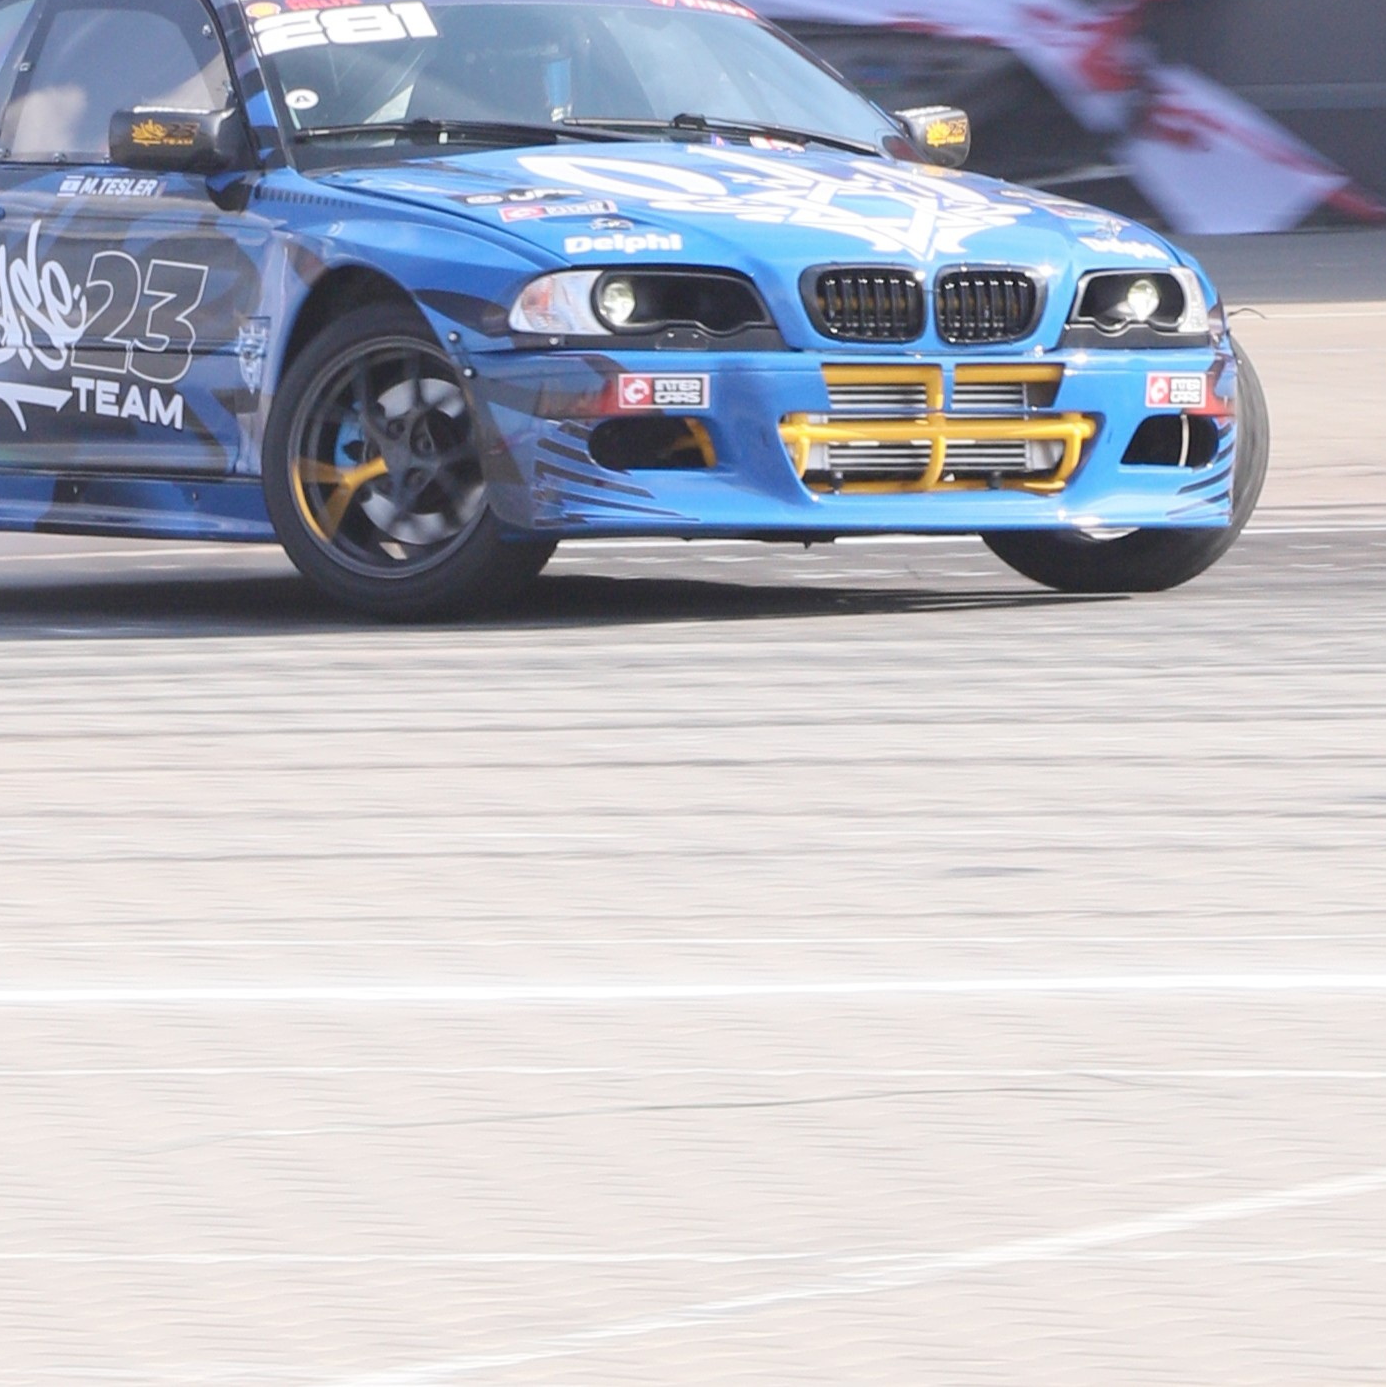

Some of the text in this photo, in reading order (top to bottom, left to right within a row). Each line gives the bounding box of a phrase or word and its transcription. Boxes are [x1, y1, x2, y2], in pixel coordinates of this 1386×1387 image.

[249, 1, 439, 56] 281
[79, 177, 158, 196] M.TESLER
[564, 233, 683, 254] Delphi
[71, 250, 209, 384] 23
[71, 376, 184, 431] TEAM
